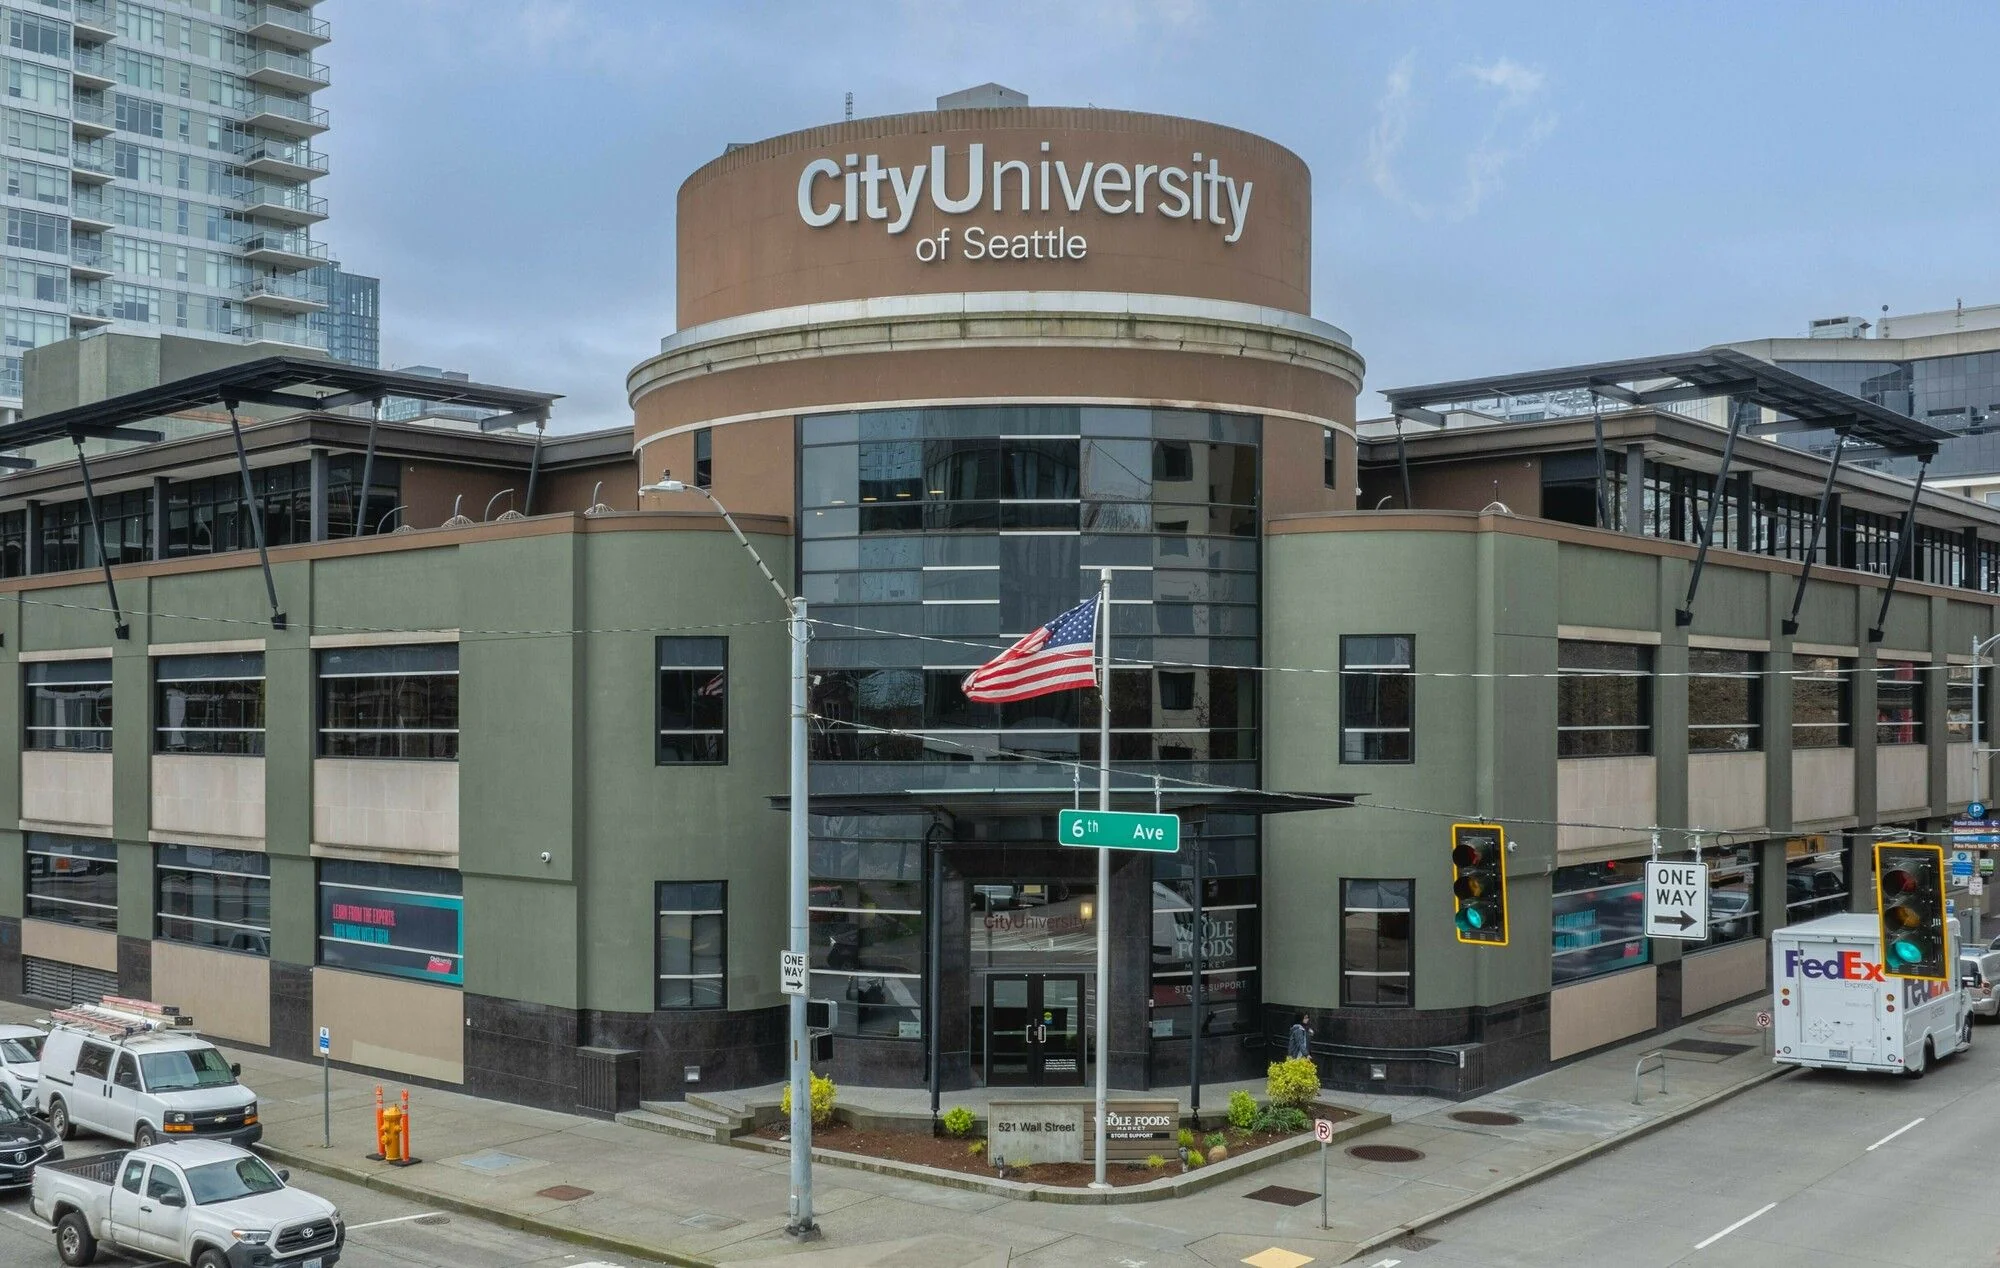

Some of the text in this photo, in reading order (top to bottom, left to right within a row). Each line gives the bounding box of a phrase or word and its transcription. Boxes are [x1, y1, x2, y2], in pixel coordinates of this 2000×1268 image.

[798, 141, 1253, 243] CityUniversity
[915, 226, 1087, 262] of Seattle
[1133, 823, 1164, 841] Ave
[1658, 869, 1696, 886] ONE
[1656, 889, 1697, 907] WAY
[784, 955, 803, 966] ONE
[1185, 961, 1226, 970] MRKET
[1785, 949, 1885, 982] FedEx
[784, 966, 803, 977] WAY
[1175, 980, 1247, 994] STOE SUPPORT
[998, 1122, 1075, 1132] 521 Wall Street
[1135, 1116, 1170, 1126] FOODS
